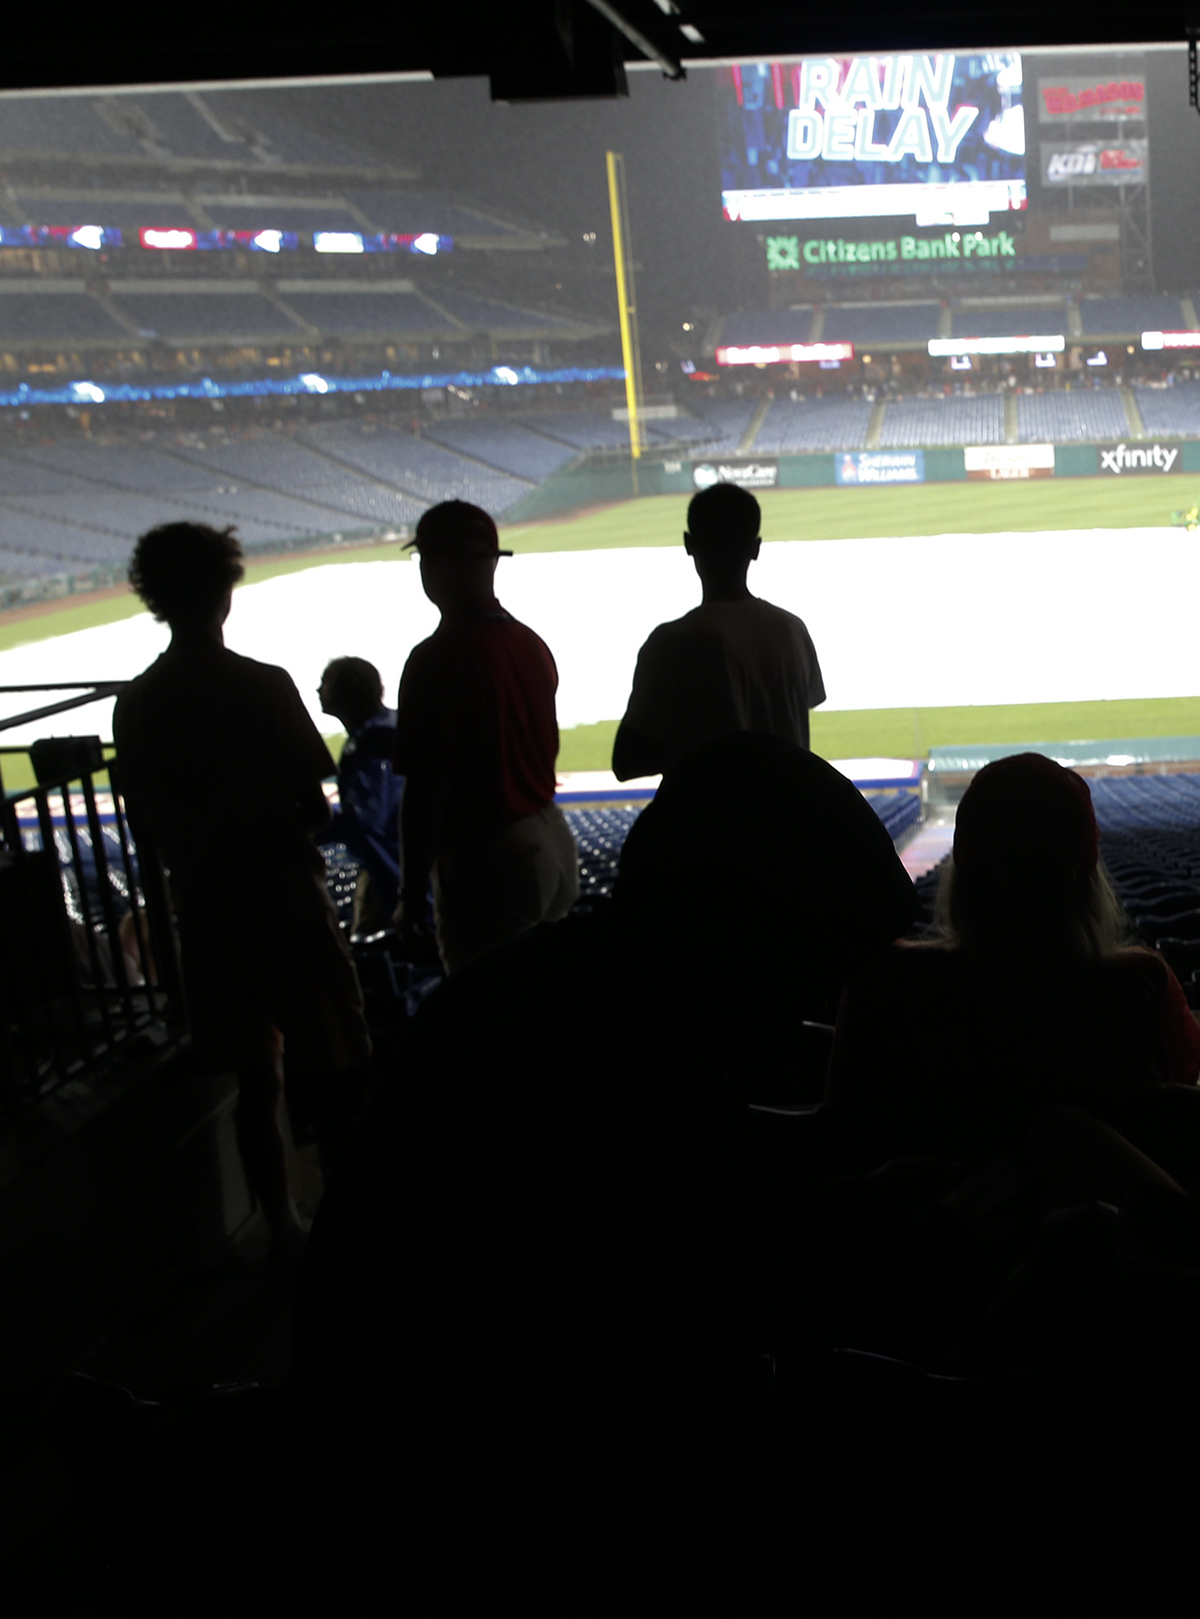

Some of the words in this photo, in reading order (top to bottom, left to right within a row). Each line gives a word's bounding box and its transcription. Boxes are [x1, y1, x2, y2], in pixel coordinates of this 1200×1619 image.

[799, 53, 955, 110] RAIN
[786, 106, 980, 163] DELAY
[803, 234, 898, 265] Citizens
[901, 232, 960, 261] Bank
[963, 230, 1016, 257] Park
[1101, 443, 1178, 474] xfinity
